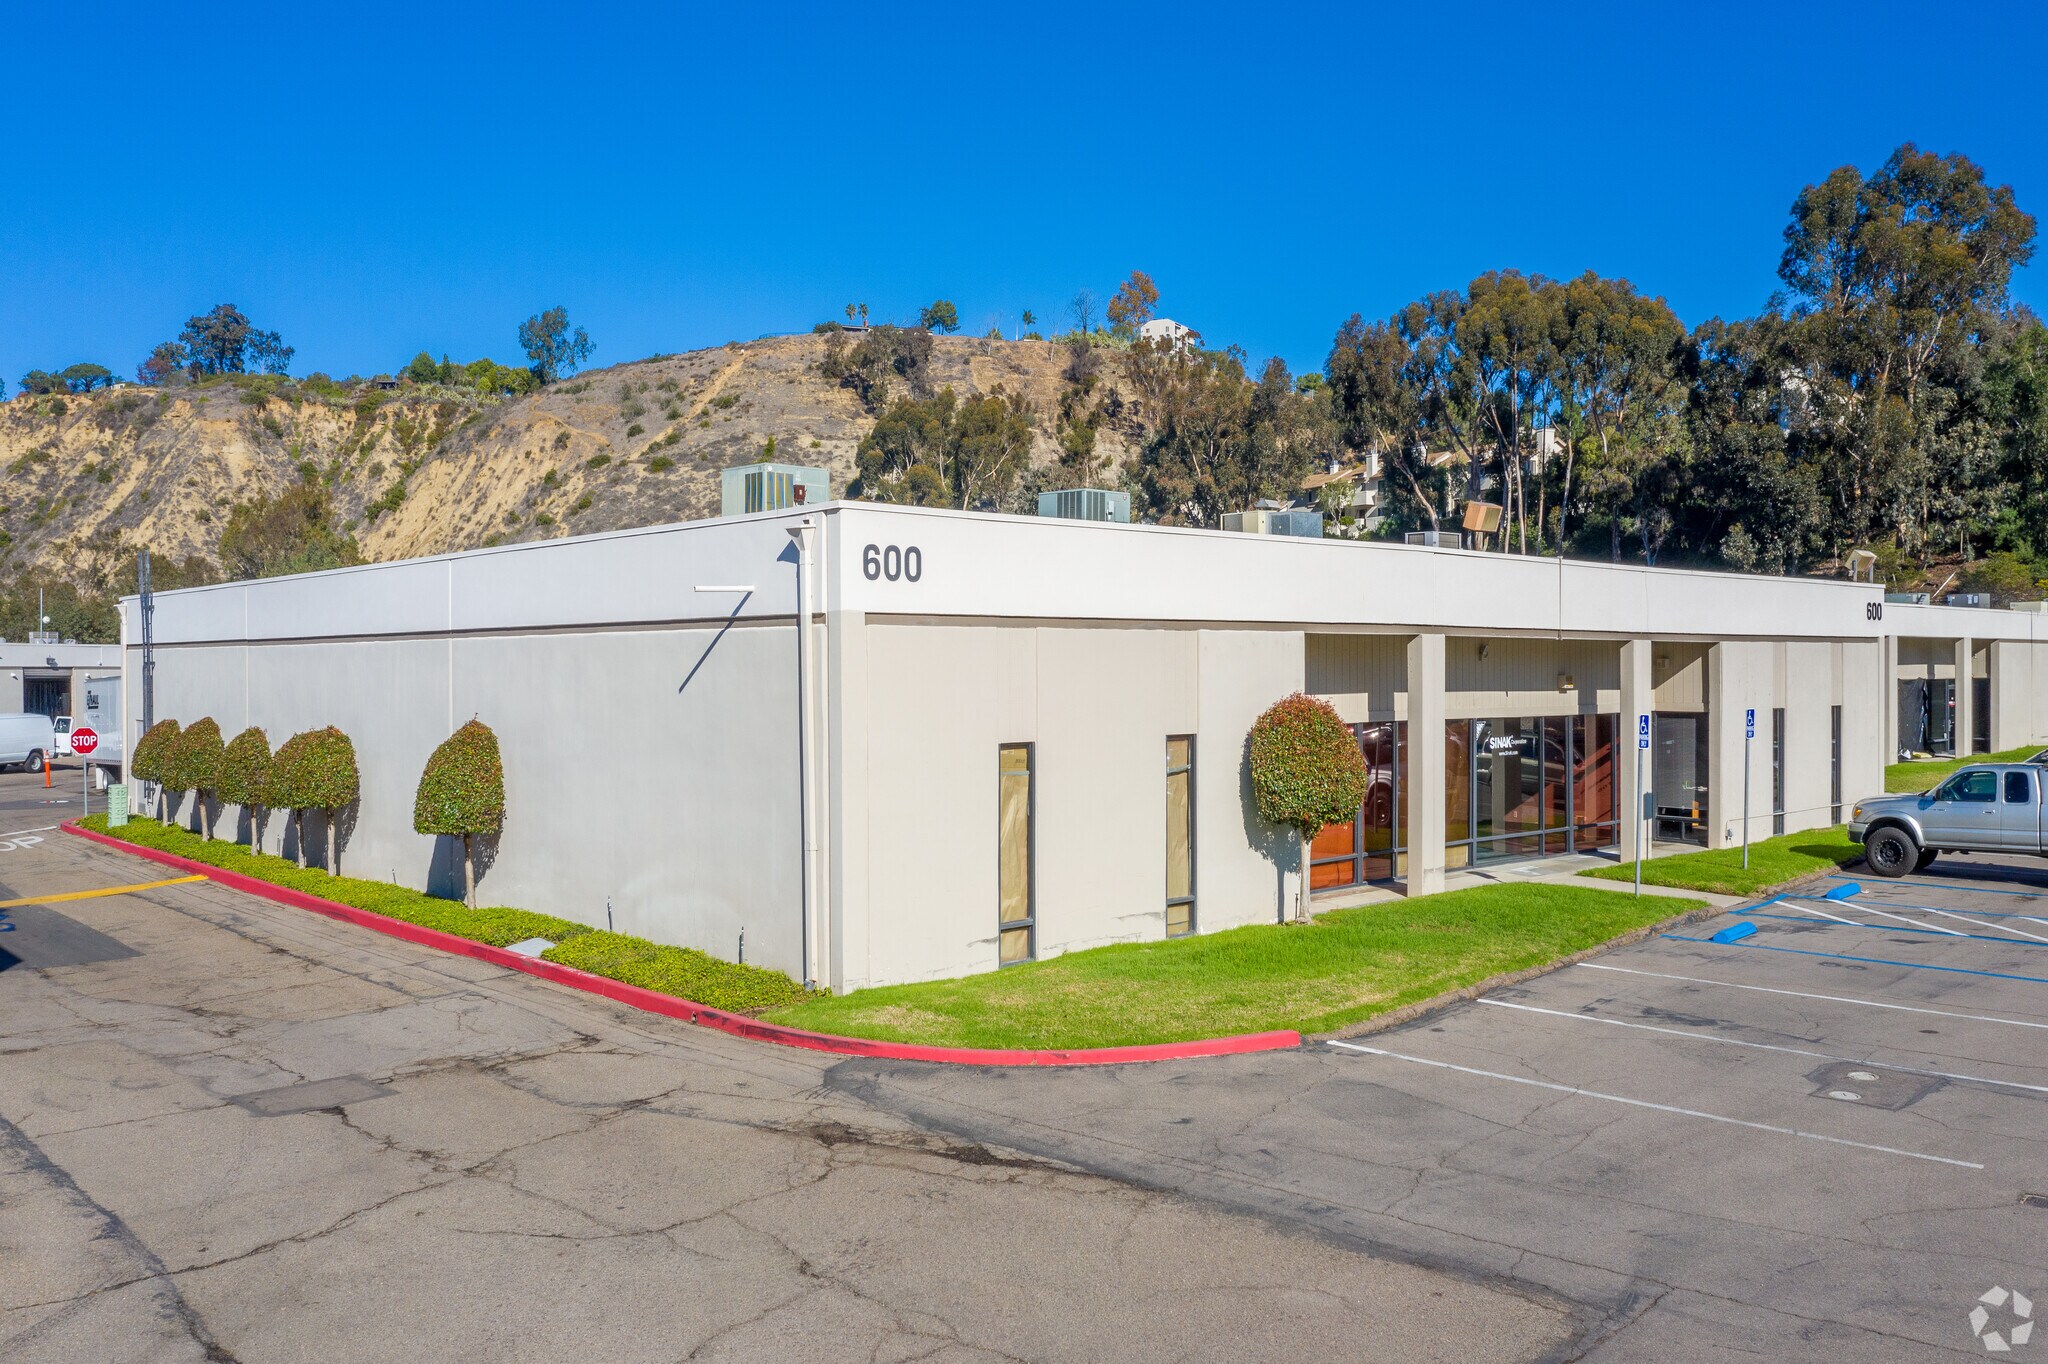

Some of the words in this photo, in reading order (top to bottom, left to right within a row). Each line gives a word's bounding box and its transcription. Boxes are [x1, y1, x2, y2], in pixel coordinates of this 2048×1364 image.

[863, 544, 922, 583] 600
[1867, 602, 1882, 621] 600
[72, 735, 97, 747] STOP
[1490, 736, 1512, 749] SINAK
